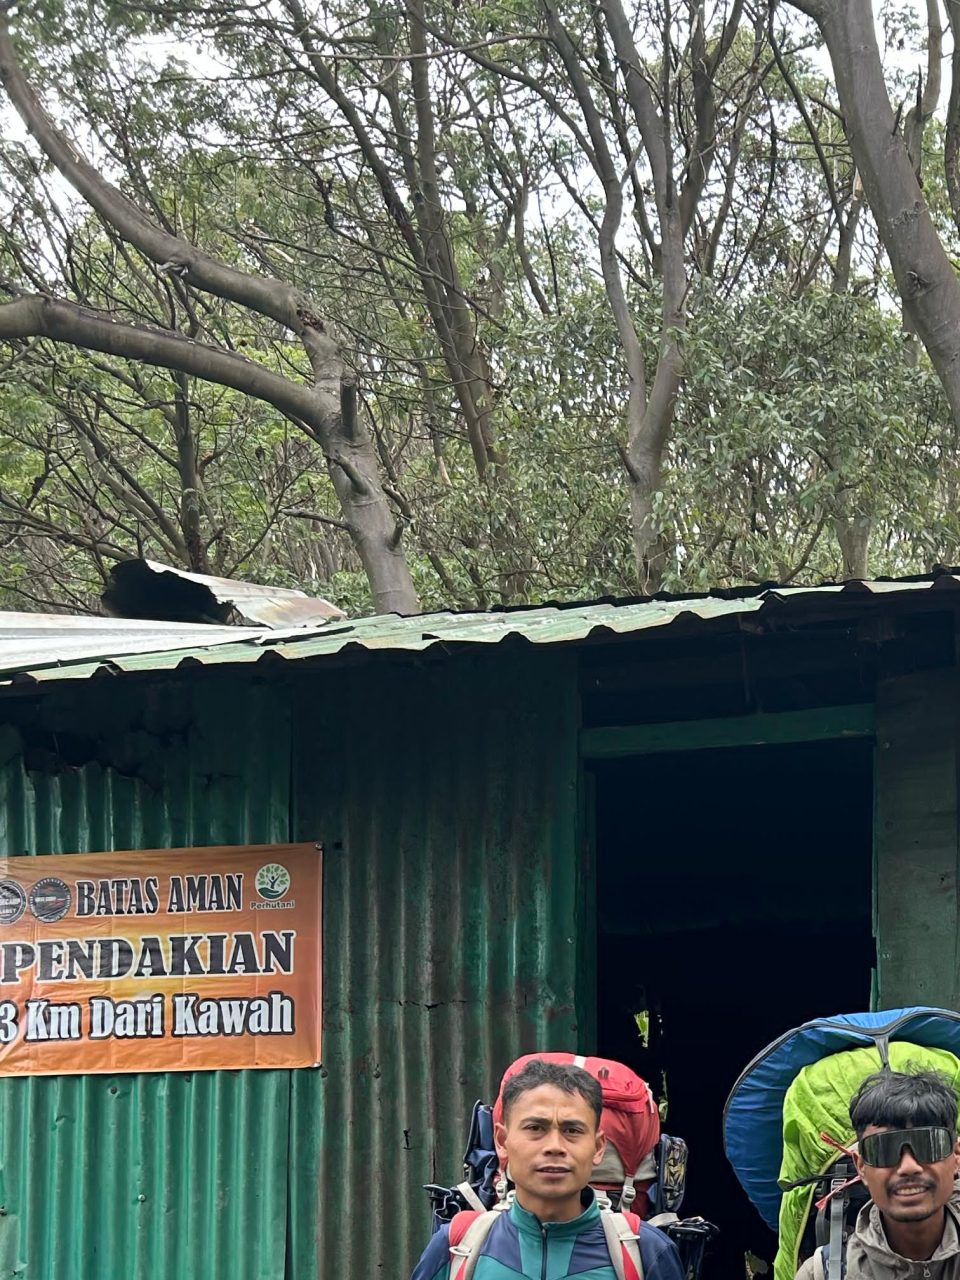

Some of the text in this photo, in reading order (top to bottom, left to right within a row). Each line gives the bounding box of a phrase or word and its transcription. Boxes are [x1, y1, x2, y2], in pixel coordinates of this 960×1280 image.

[75, 877, 158, 917] BATAS
[167, 873, 243, 914] AMAN
[250, 899, 295, 910] Perhutani
[1, 931, 296, 985] PENDAKIAN
[25, 1000, 81, 1041] Km
[89, 995, 164, 1039] Dari
[173, 993, 294, 1036] Kawah
